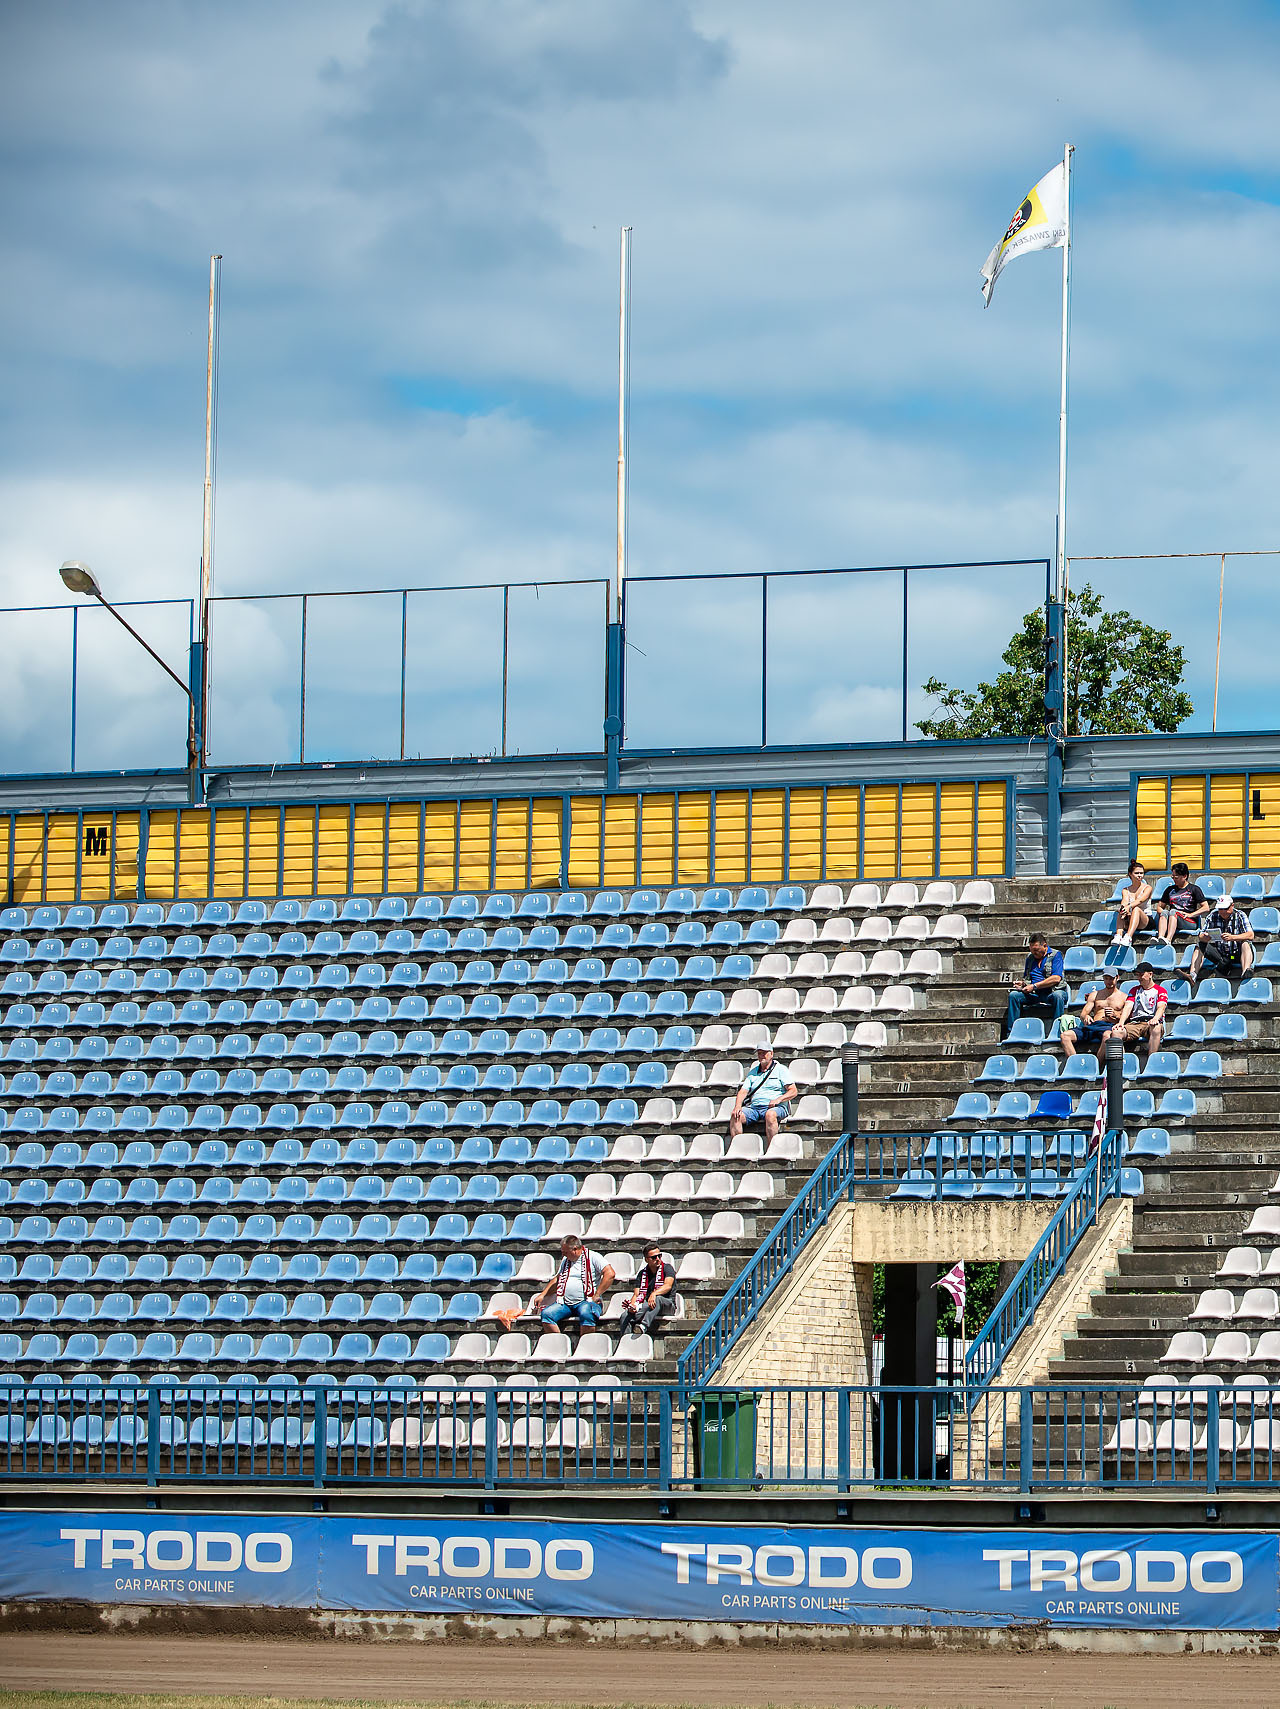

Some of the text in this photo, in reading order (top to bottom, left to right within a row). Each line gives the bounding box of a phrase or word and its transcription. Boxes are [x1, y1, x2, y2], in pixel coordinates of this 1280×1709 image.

[1253, 790, 1265, 820] L
[85, 828, 107, 856] M
[60, 1529, 292, 1572] TRODO
[352, 1535, 593, 1580] TRODO
[661, 1543, 912, 1589] TRODO
[983, 1550, 1243, 1593] TRODO
[115, 1579, 234, 1592] CAR PARTS ONLINE
[410, 1586, 533, 1600] CAR PARTS ONLINE
[722, 1595, 849, 1610] CAR PARTS ONLINE
[1046, 1601, 1179, 1614] CAR PARTS ONLINE
